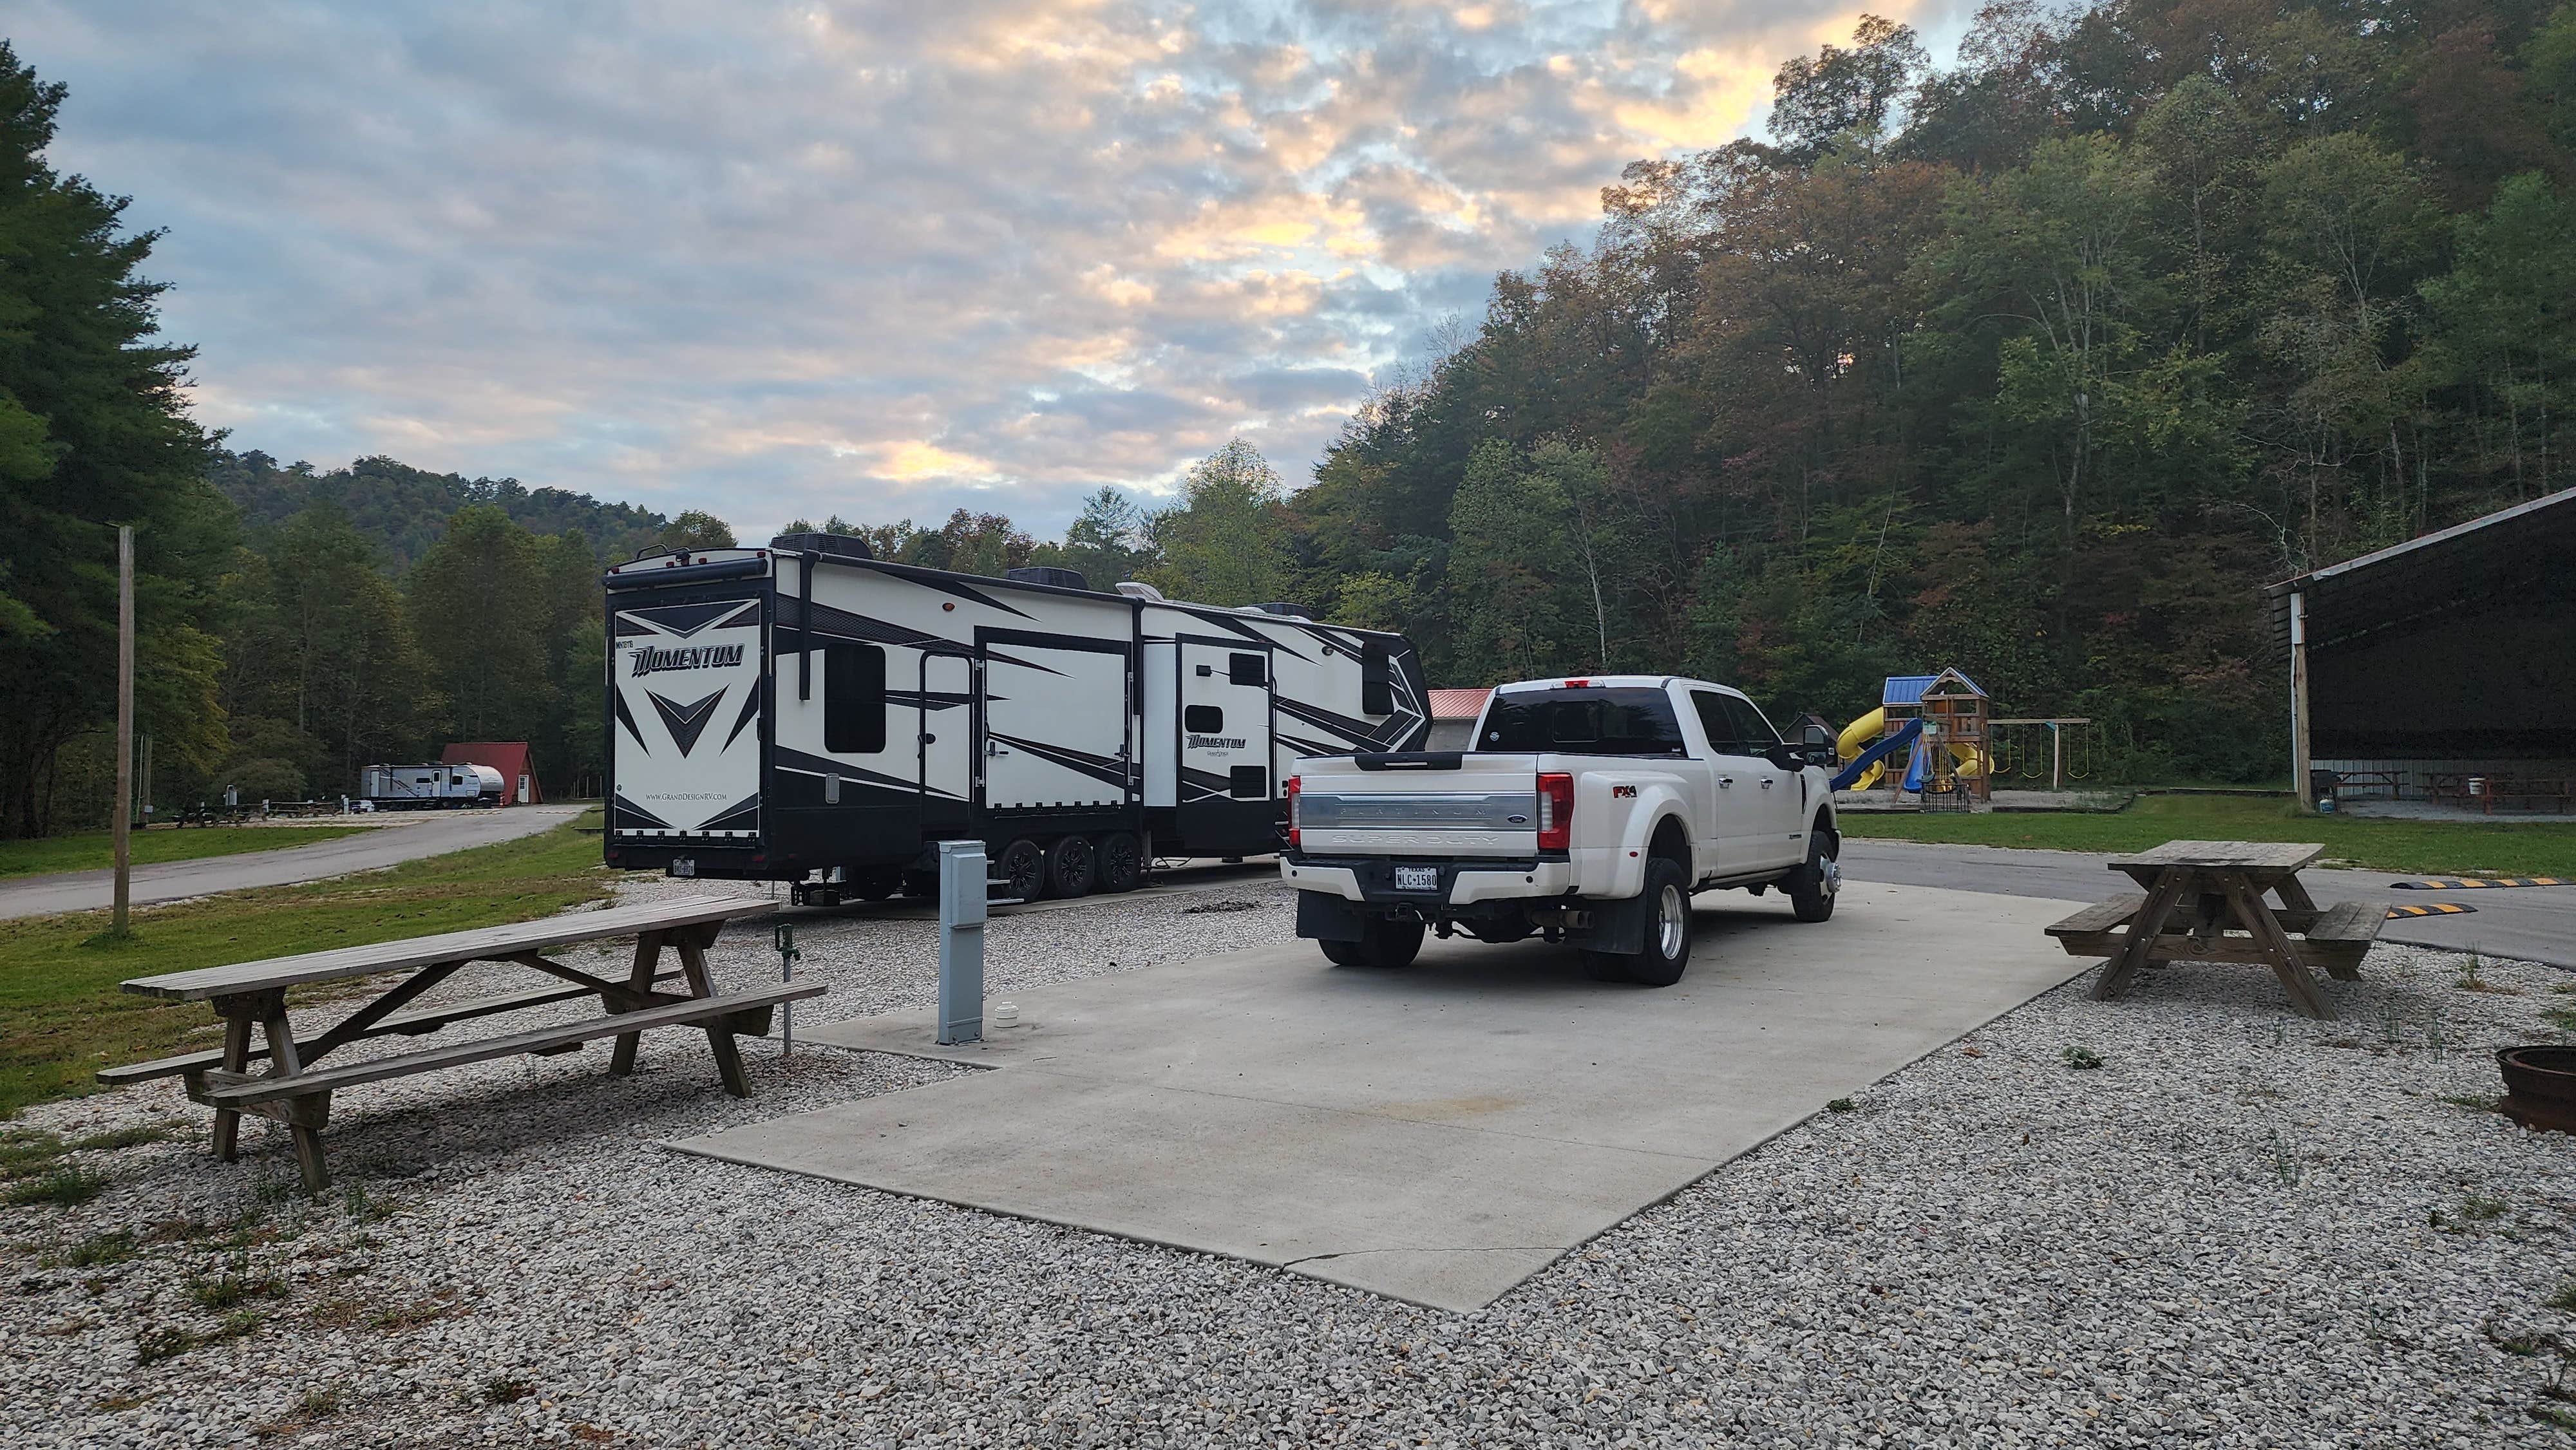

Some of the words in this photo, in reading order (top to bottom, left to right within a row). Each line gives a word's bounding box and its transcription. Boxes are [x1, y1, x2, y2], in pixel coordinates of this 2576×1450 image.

[628, 643, 745, 678] MOMENTUM
[1185, 735, 1246, 749] MOMENTUM
[1613, 786, 1637, 798] FX4
[1332, 835, 1419, 843] SUPER
[1426, 836, 1499, 845] DUTY
